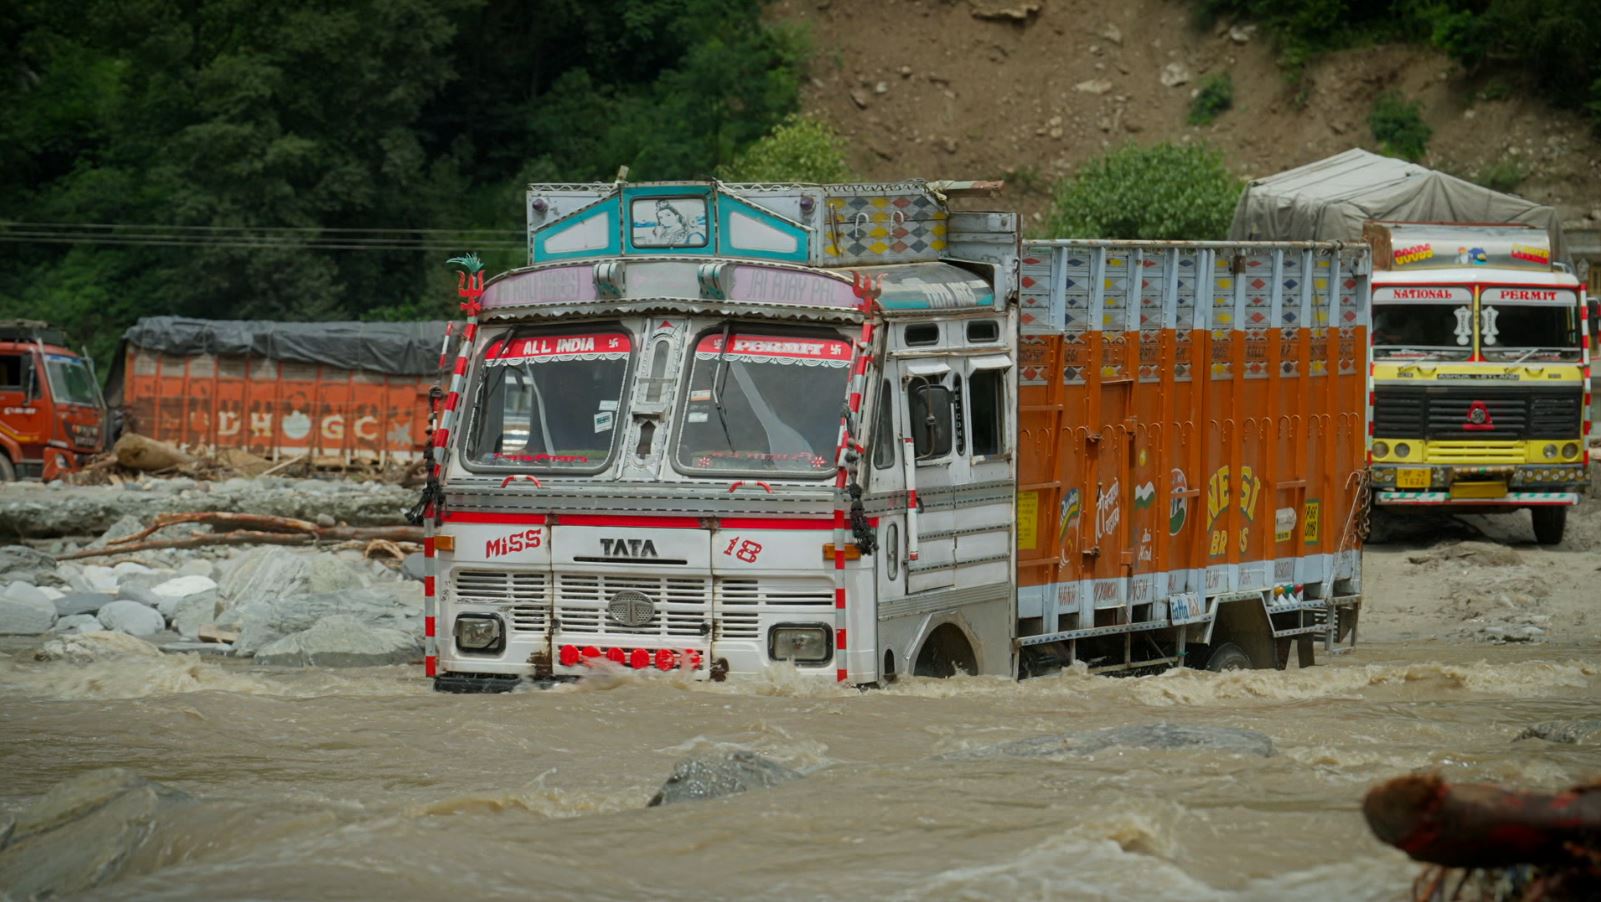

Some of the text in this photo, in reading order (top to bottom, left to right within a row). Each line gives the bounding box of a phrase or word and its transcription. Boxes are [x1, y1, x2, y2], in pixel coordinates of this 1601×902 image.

[1393, 288, 1557, 301] NATIONAL PERMIT
[523, 338, 594, 355] ALL INDIA
[733, 341, 825, 355] PERMIT
[600, 538, 658, 557] TATA
[723, 536, 763, 564] 18
